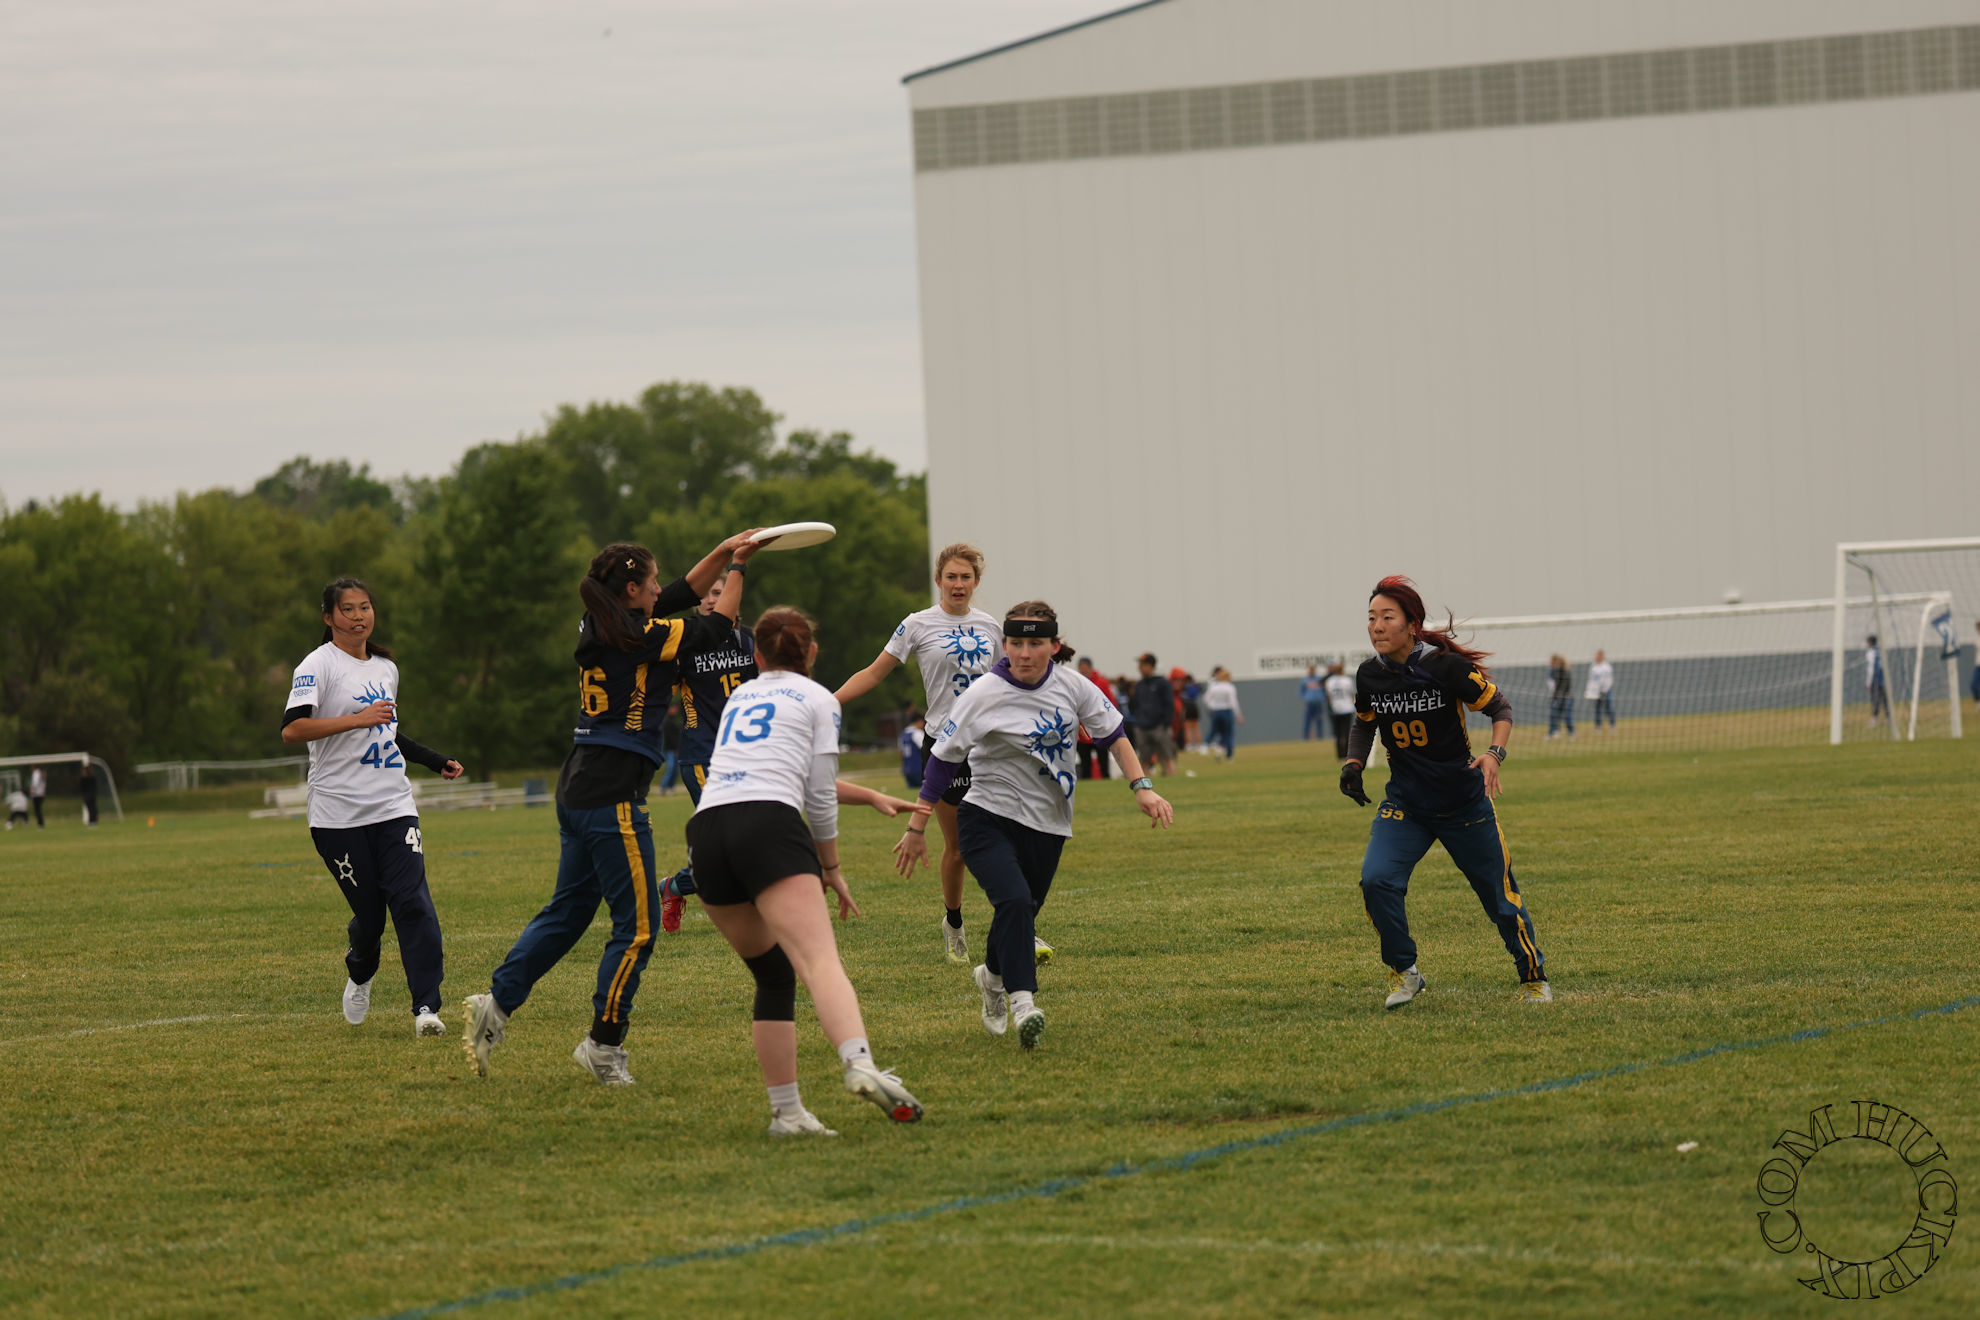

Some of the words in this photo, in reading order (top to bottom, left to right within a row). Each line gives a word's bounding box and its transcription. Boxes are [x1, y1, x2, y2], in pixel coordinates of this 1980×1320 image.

[1370, 689, 1441, 702] MICHIGAN
[720, 702, 776, 746] 13
[1391, 720, 1429, 749] 99
[360, 740, 403, 769] 42
